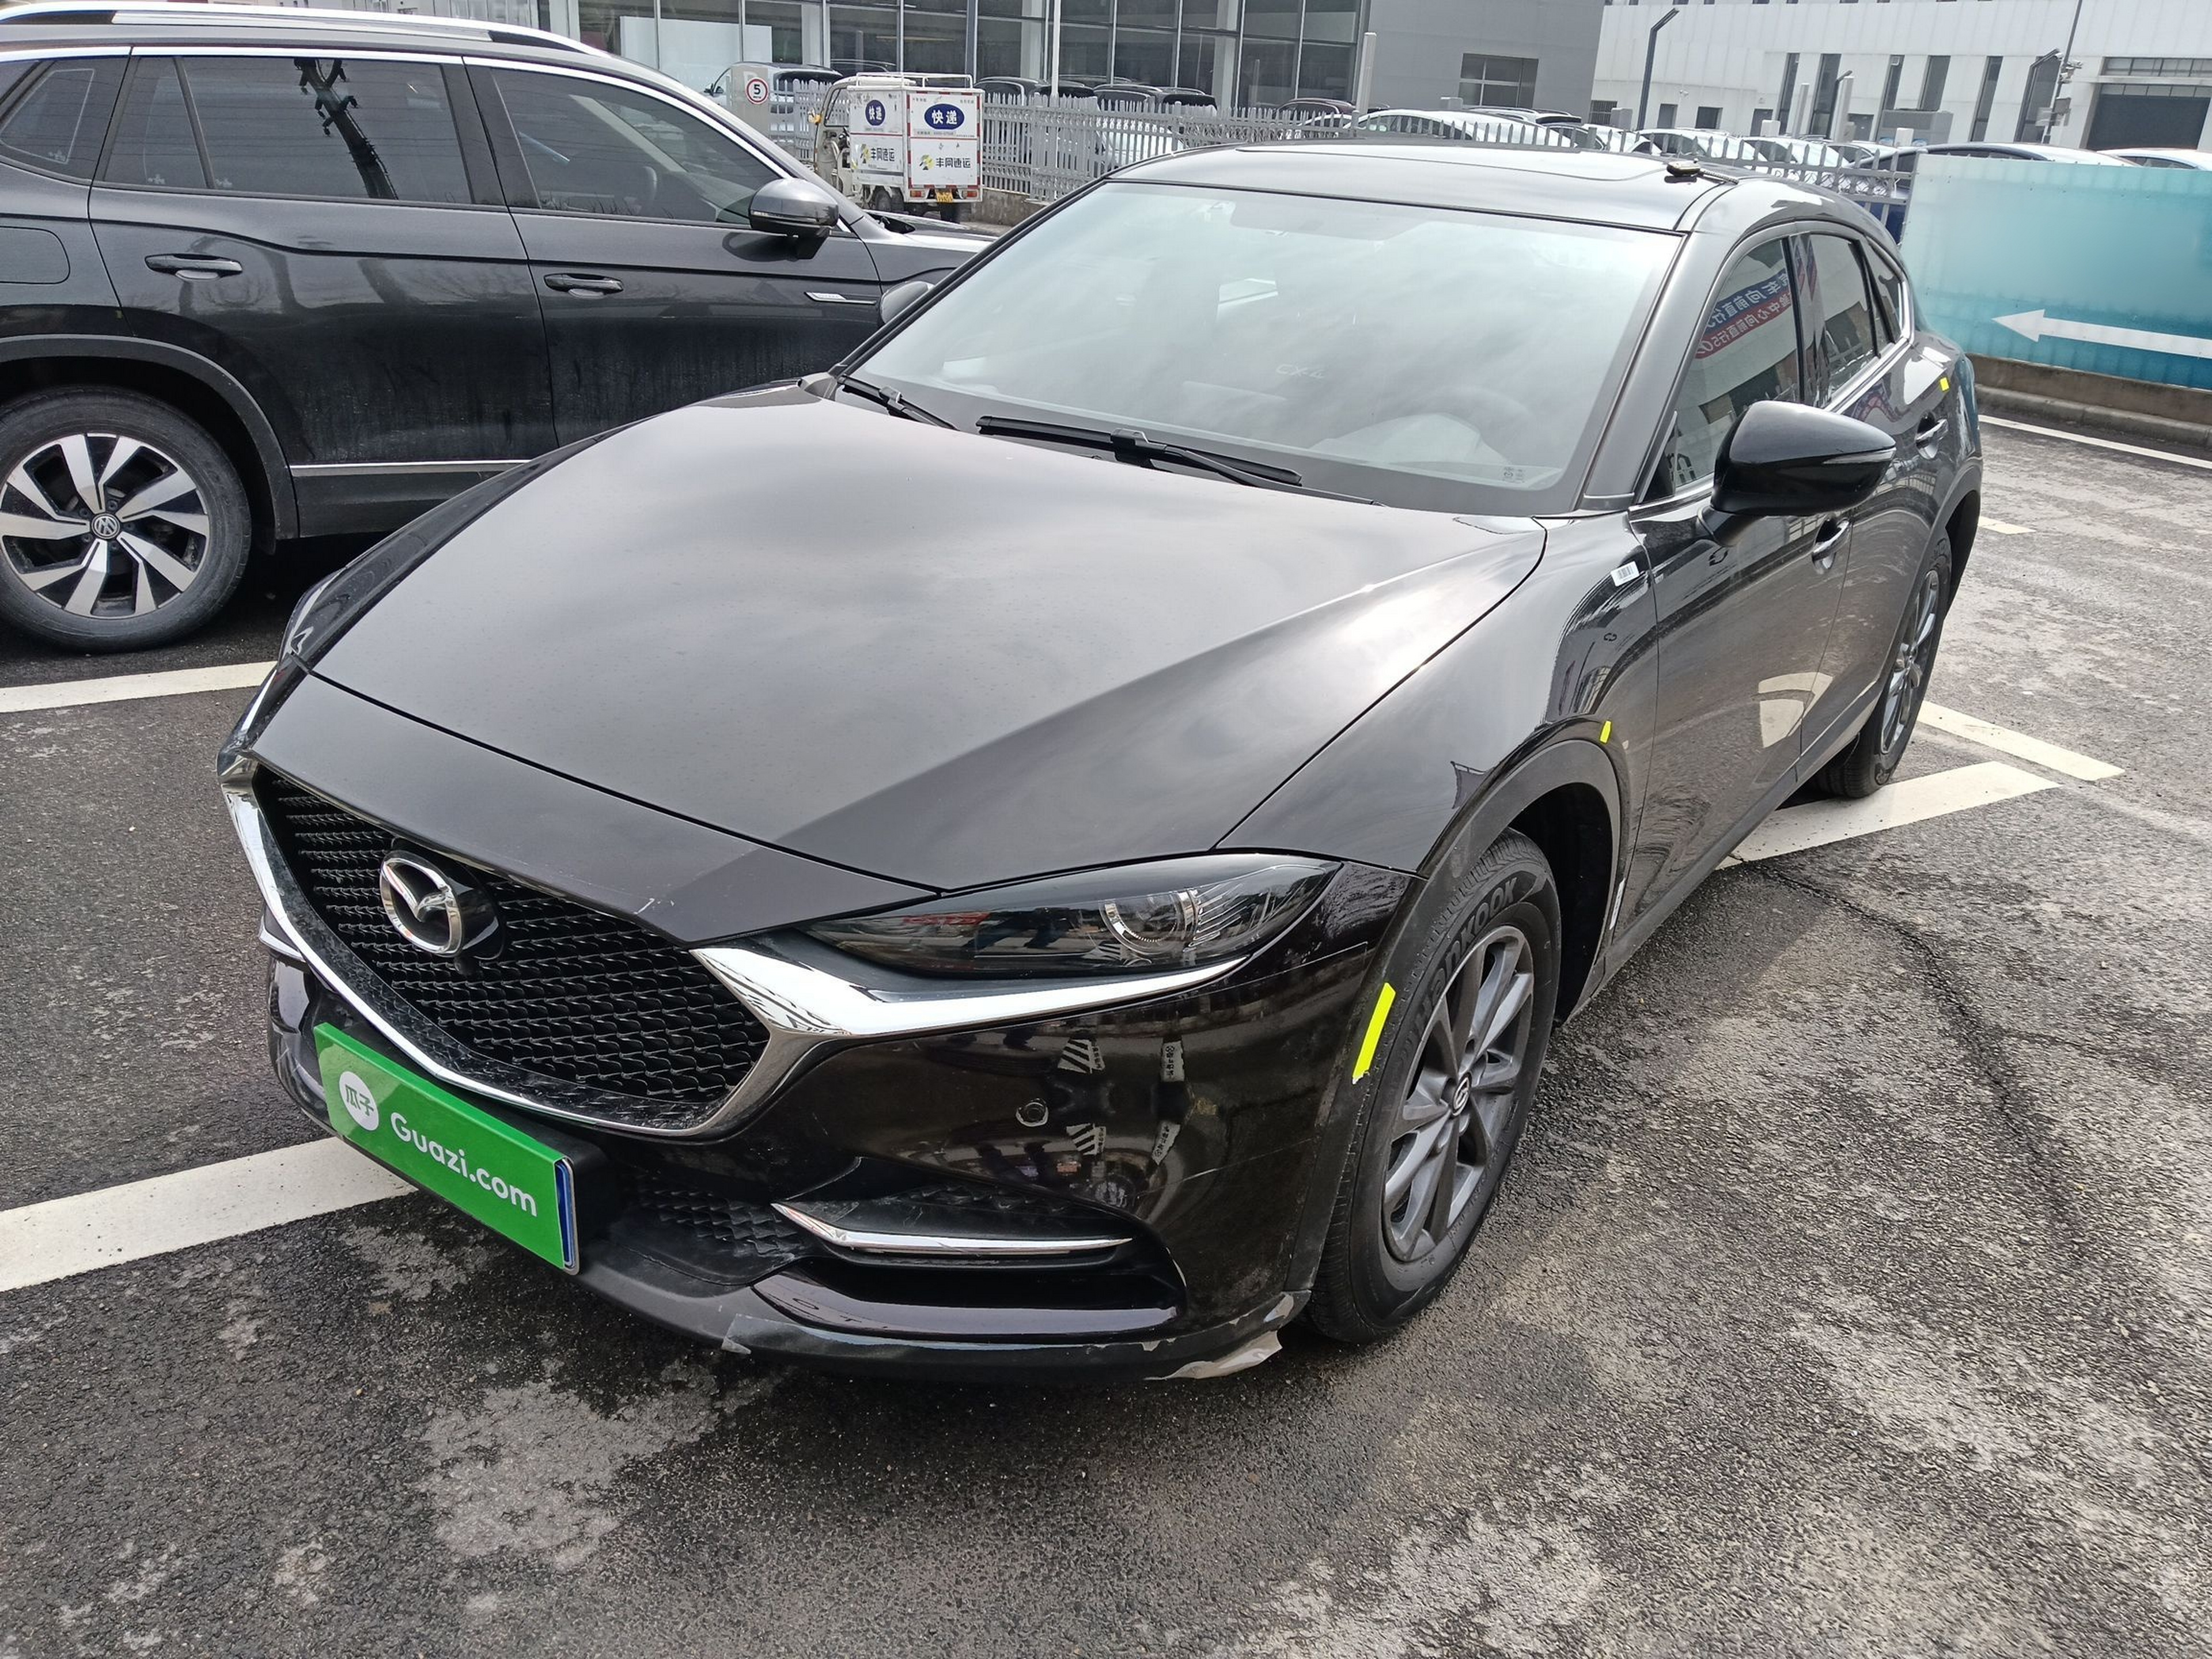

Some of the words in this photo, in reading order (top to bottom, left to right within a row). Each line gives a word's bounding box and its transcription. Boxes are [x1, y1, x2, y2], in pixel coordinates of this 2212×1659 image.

[753, 84, 761, 95] 5
[869, 105, 882, 120] 快递
[931, 109, 957, 125] 快递
[870, 147, 895, 162] 丰网速运
[935, 157, 971, 168] 丰网速运
[345, 1084, 374, 1116] 瓜子
[390, 1112, 537, 1217] Guazi.com
